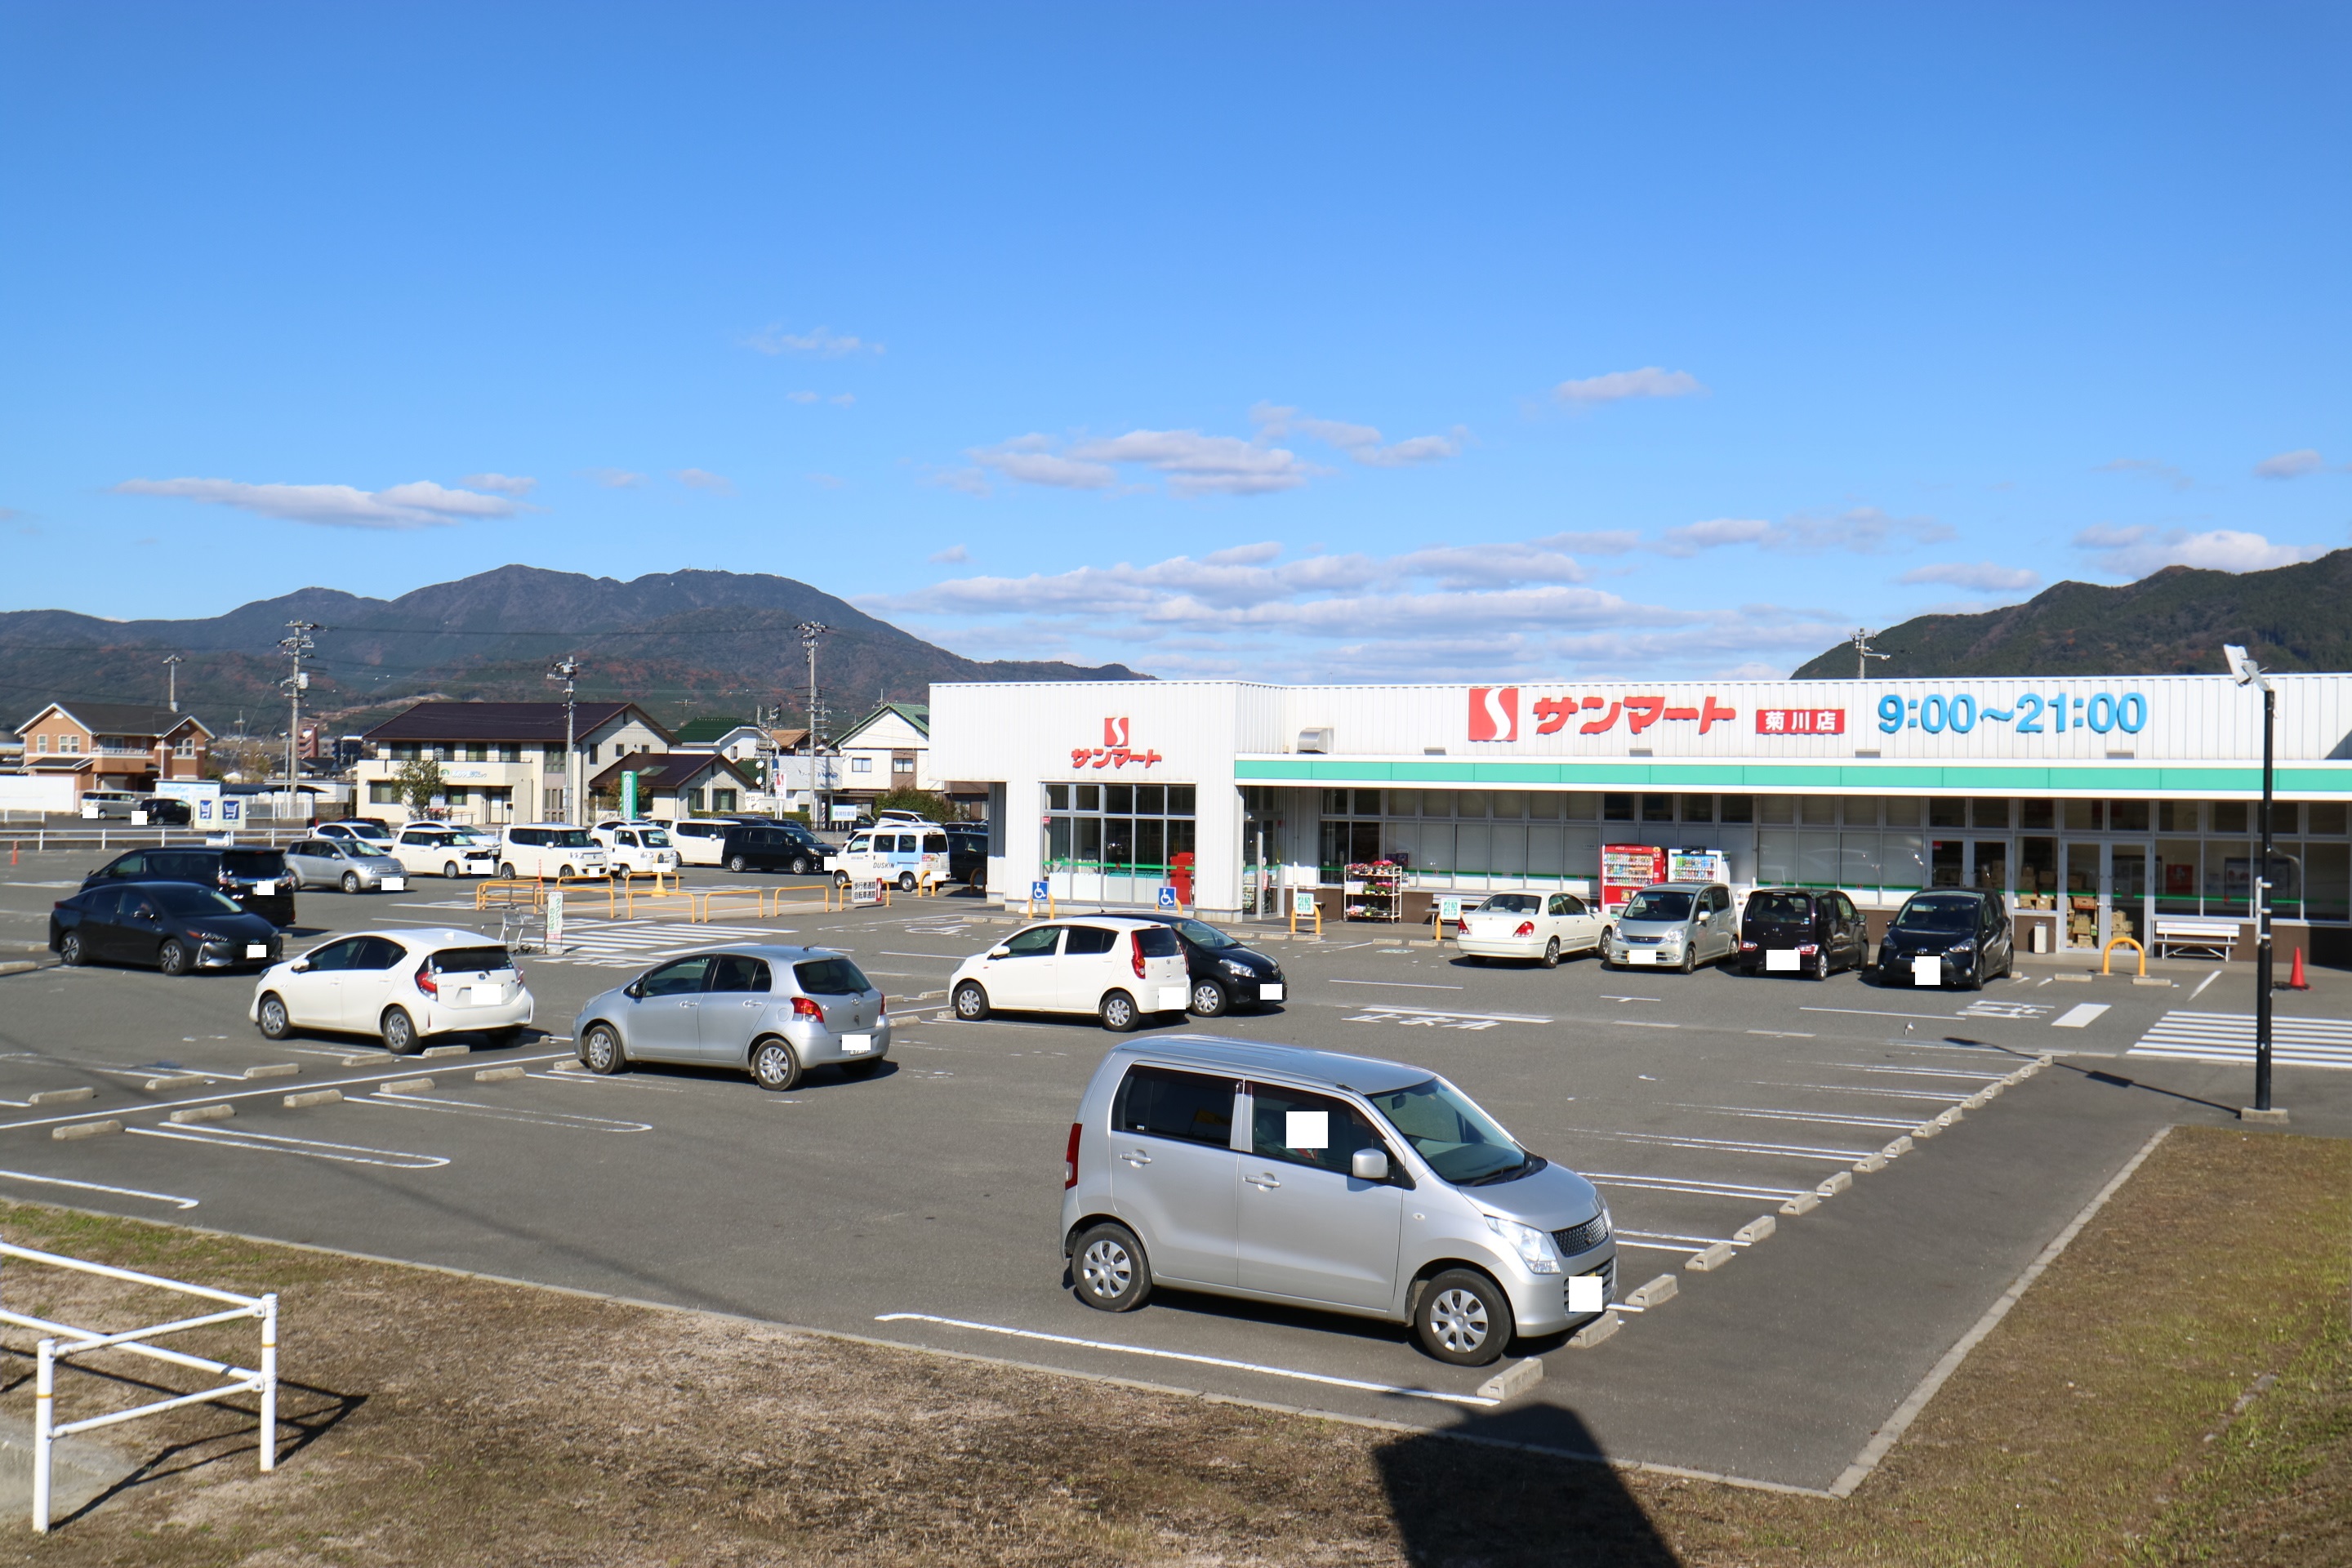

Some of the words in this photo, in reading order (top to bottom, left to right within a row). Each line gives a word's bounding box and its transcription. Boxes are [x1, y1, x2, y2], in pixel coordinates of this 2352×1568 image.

[1533, 696, 1737, 734] サンマート
[1766, 710, 1836, 731] 菊川店
[1071, 749, 1162, 768] サンマート
[854, 881, 875, 889] 歩行者通路
[854, 891, 875, 899] 自転車通路
[1341, 1013, 1500, 1030] 止まれ
